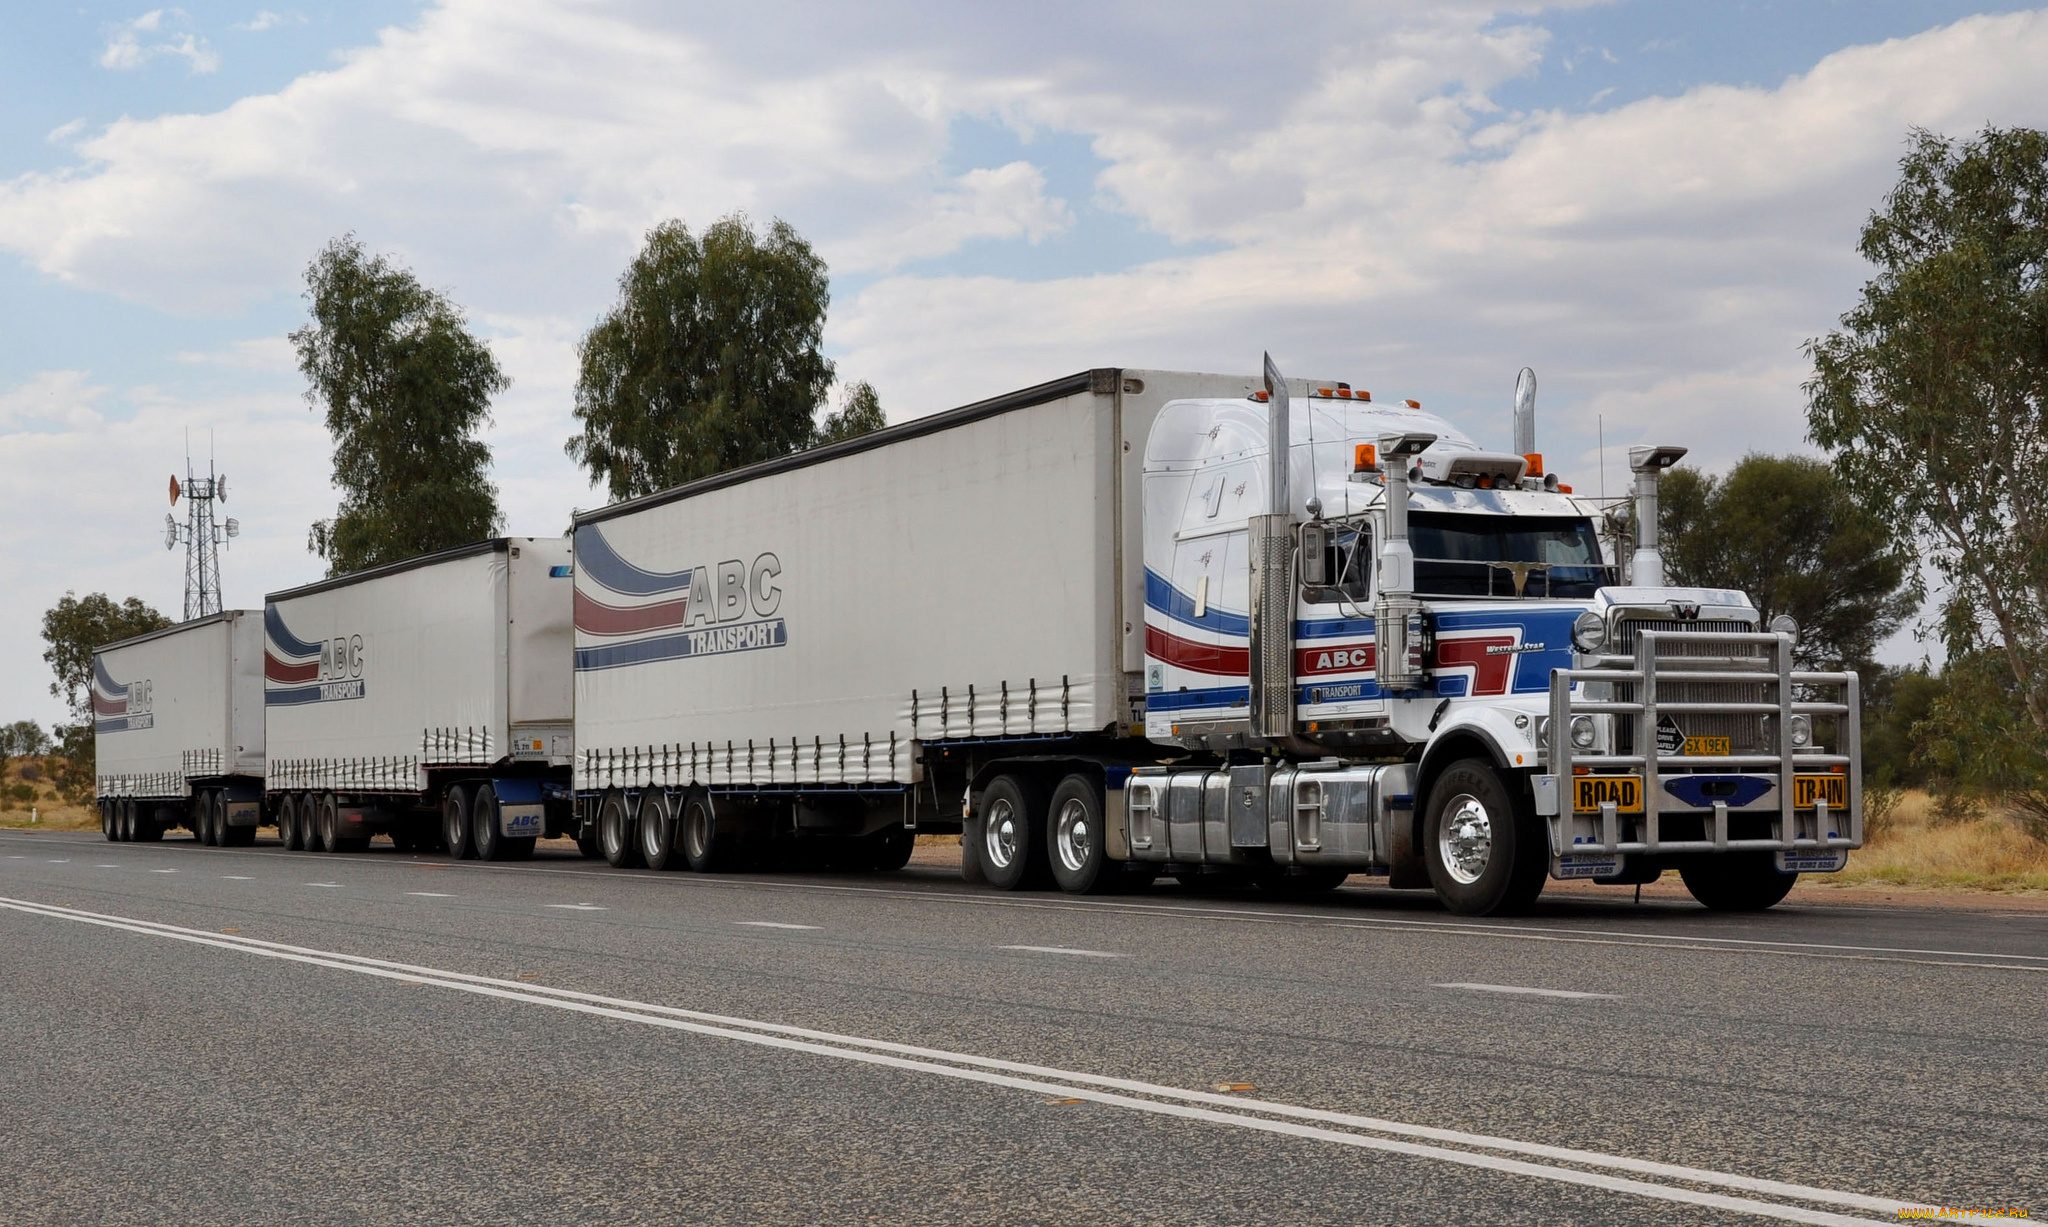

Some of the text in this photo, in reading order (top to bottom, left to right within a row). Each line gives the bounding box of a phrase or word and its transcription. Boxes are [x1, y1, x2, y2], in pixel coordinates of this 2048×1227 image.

[684, 552, 781, 628] ABC
[688, 623, 778, 655] TRANSPORT
[318, 634, 363, 682] ABC
[1316, 650, 1366, 669] ABC
[126, 679, 152, 715] ABC
[320, 682, 361, 700] TRANSPORT
[1322, 685, 1361, 698] TRANSPORT
[1580, 781, 1635, 807] ROAD
[1797, 779, 1843, 804] TRAIN
[512, 815, 539, 826] ABC
